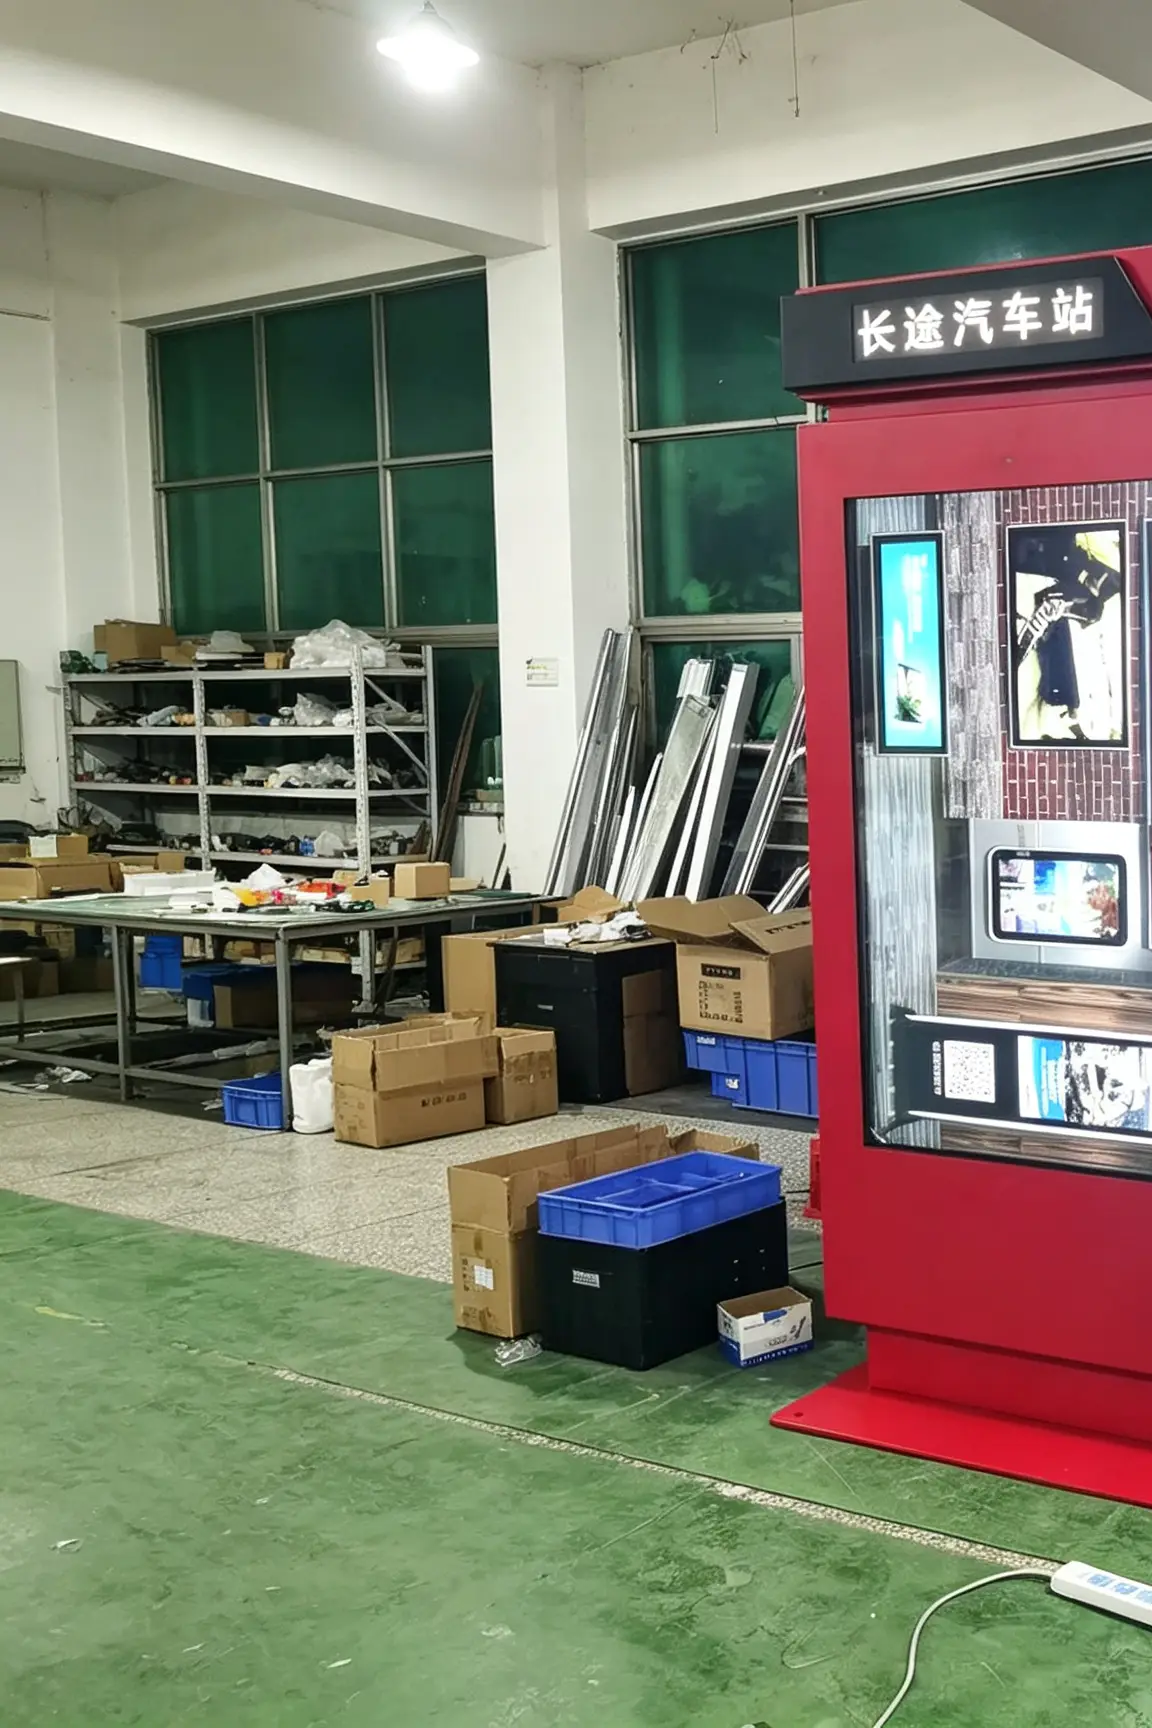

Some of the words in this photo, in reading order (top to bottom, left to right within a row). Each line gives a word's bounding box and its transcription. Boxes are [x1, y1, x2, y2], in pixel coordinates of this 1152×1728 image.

[857, 286, 1094, 357] 长途汽车站
